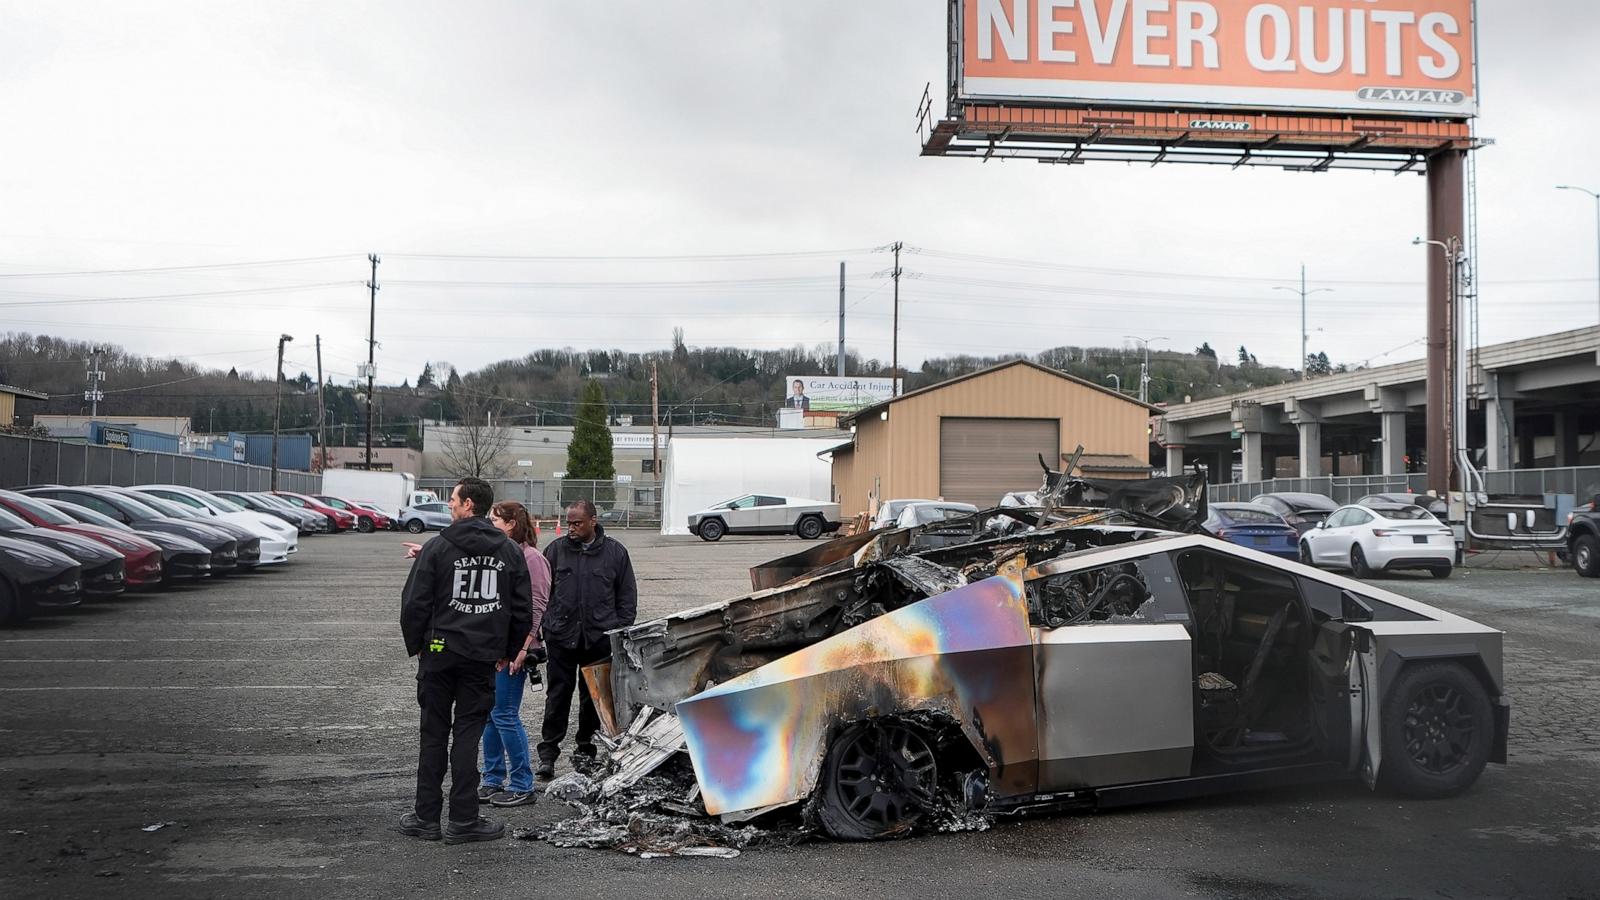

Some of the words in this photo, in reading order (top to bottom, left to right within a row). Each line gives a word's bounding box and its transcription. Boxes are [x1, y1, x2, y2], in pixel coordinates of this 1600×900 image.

[977, 0, 1219, 68] NEVER
[1244, 2, 1460, 79] QUITS
[1366, 88, 1455, 103] LAMAR
[1194, 120, 1245, 130] LAMAR
[810, 381, 825, 390] Car
[827, 381, 866, 391] Accident
[453, 555, 505, 571] SEATTLE
[448, 599, 473, 613] FIRE
[474, 601, 503, 614] DEPT.
